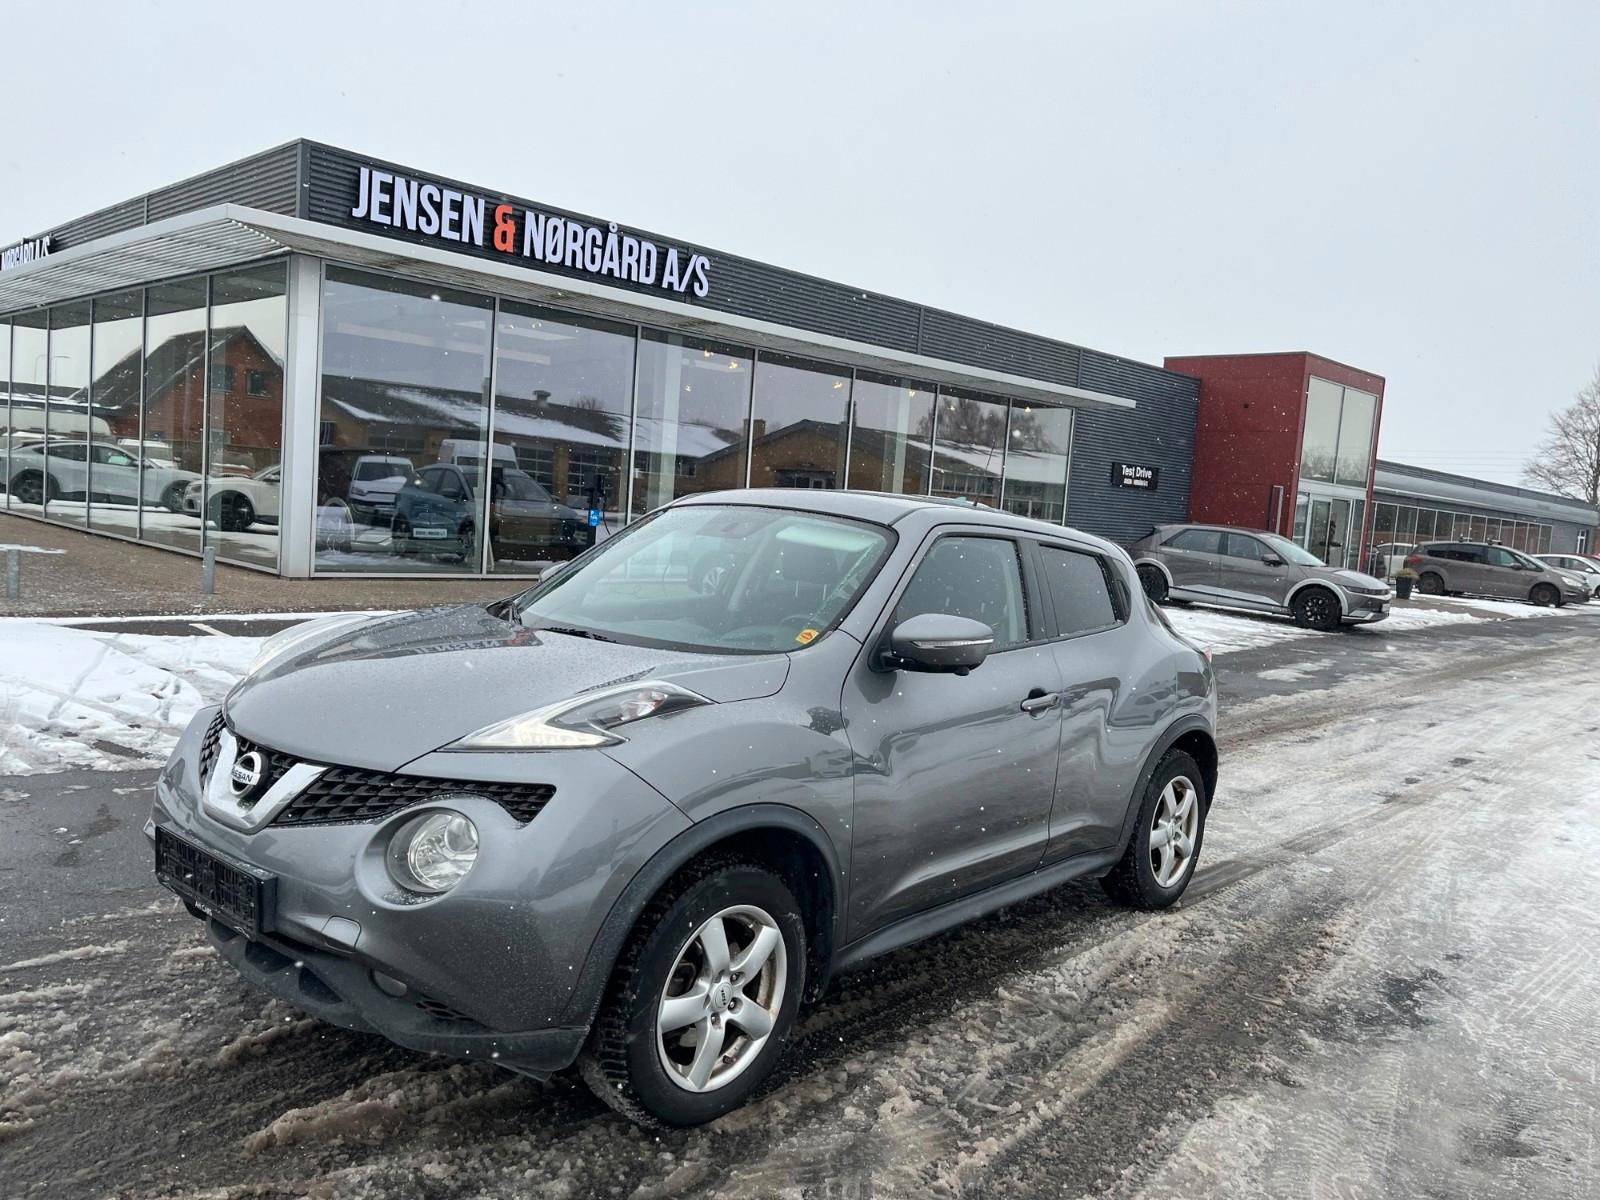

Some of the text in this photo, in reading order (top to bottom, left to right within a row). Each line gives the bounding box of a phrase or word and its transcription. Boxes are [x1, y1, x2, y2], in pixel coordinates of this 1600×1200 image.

[352, 167, 710, 298] JENSEN & NØRGÅRD A/S
[1121, 464, 1153, 479] Test Drive
